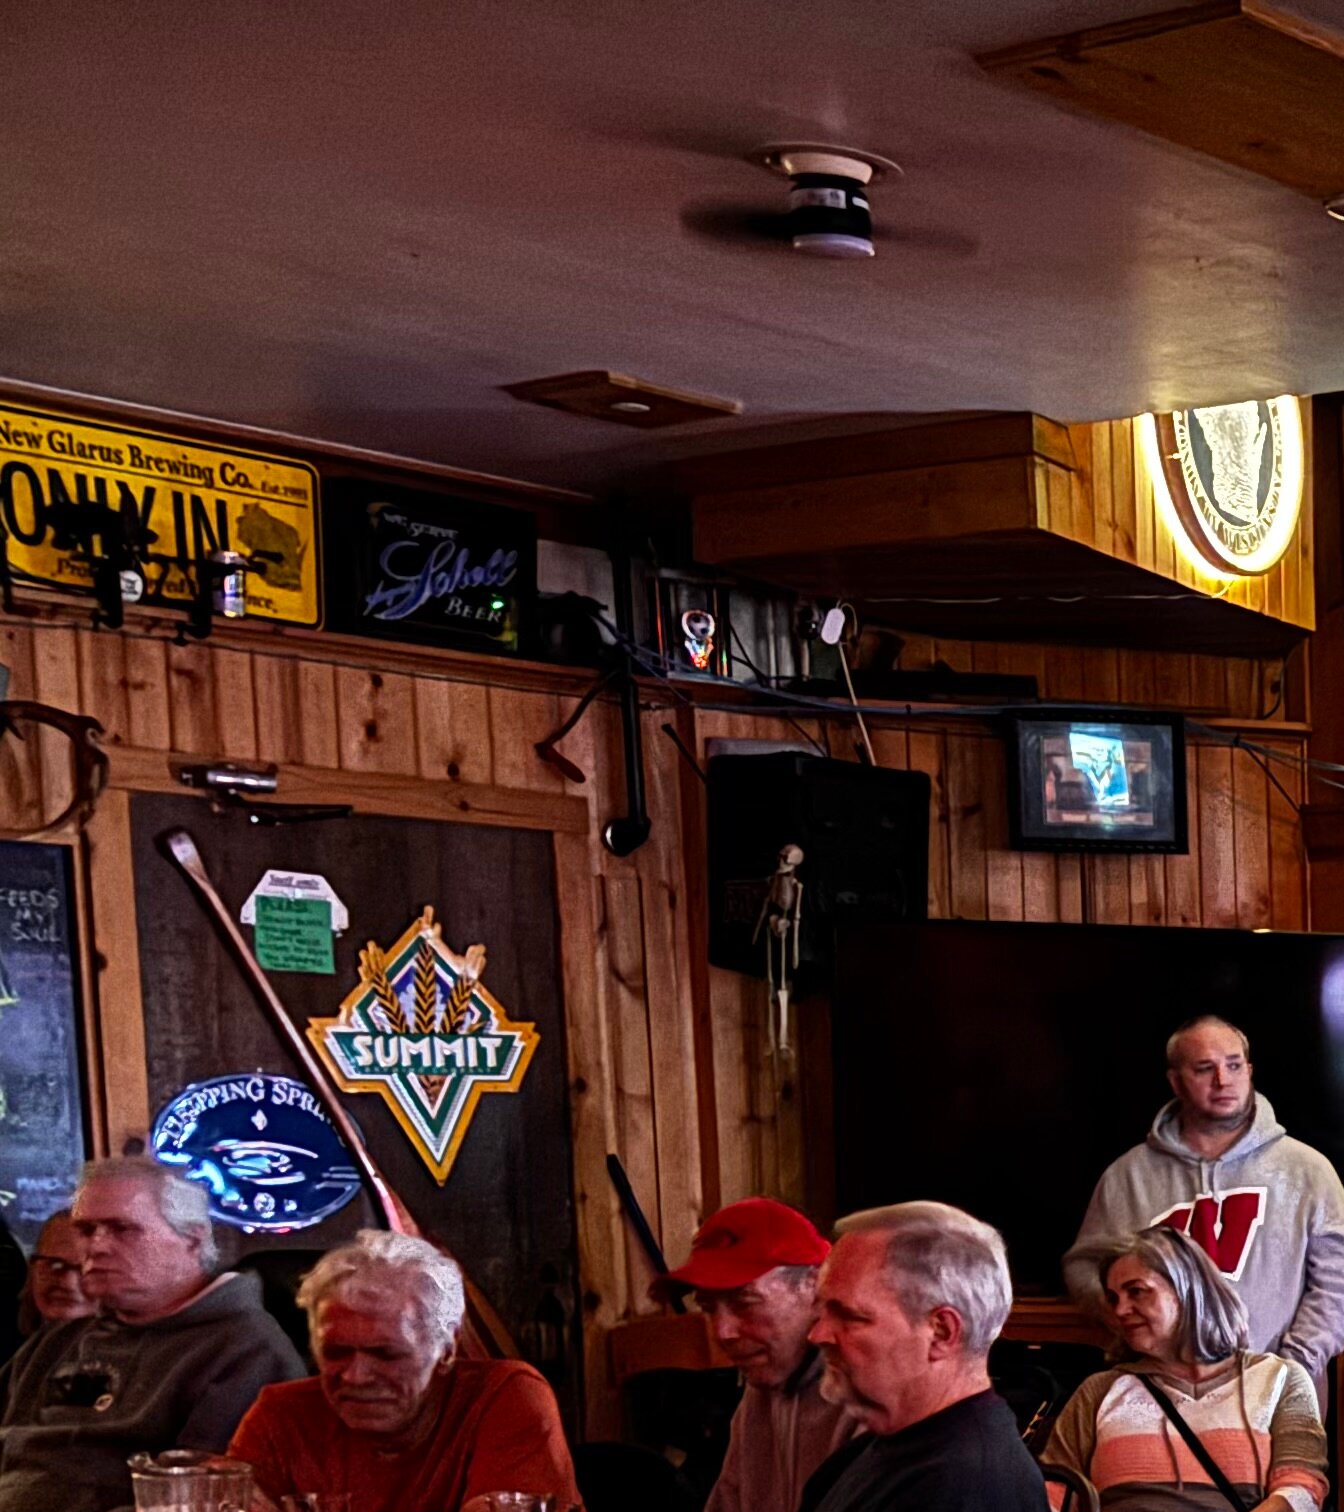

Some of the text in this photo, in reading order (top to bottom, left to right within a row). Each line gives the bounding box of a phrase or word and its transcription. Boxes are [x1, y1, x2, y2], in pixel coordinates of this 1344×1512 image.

[0, 420, 42, 448] New
[48, 429, 124, 467] Glarus
[127, 443, 214, 488] Brewing
[219, 462, 254, 489] Co.
[353, 1035, 503, 1068] SUMMIT
[1150, 1186, 1268, 1282] W
